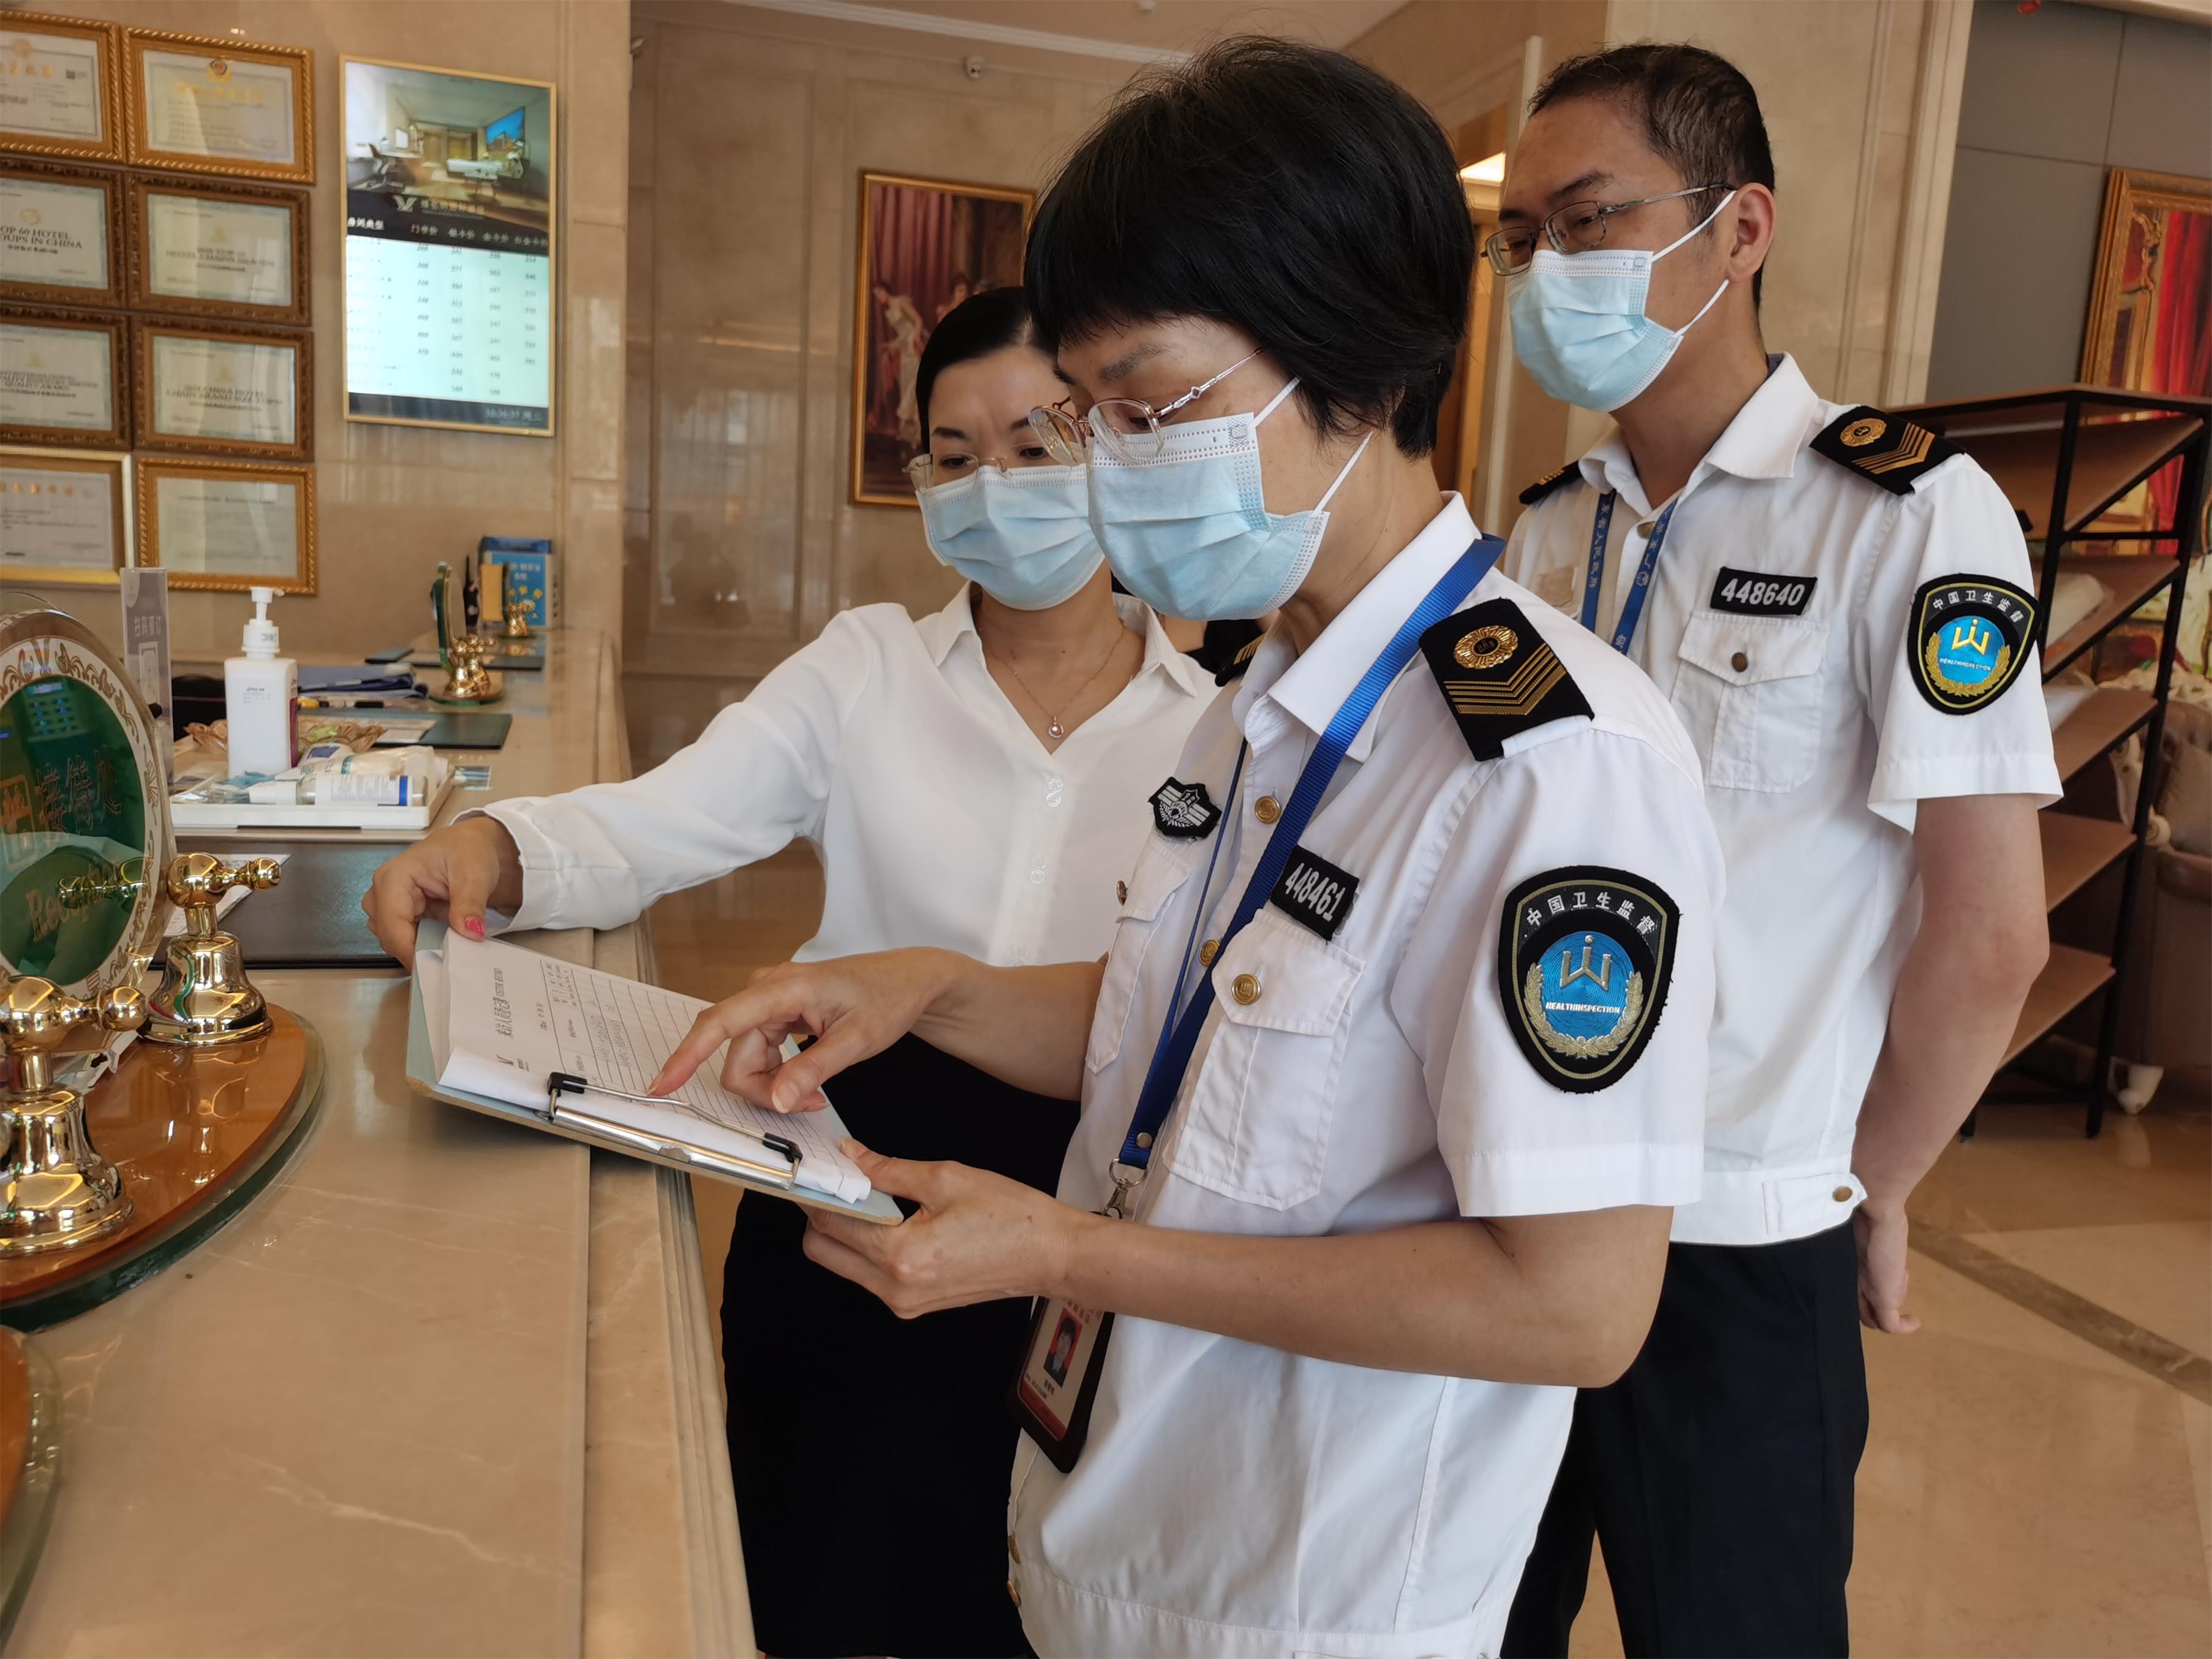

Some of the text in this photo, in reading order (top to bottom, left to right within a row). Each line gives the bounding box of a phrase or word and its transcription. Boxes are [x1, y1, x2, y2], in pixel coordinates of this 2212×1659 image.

[1720, 578, 1805, 606] 448640
[1932, 589, 2025, 623] 中国卫生监督
[1285, 862, 1346, 922] 448461
[1526, 891, 1656, 934] 中国卫生监督
[1546, 1001, 1621, 1014] HEALTHINSPECTION
